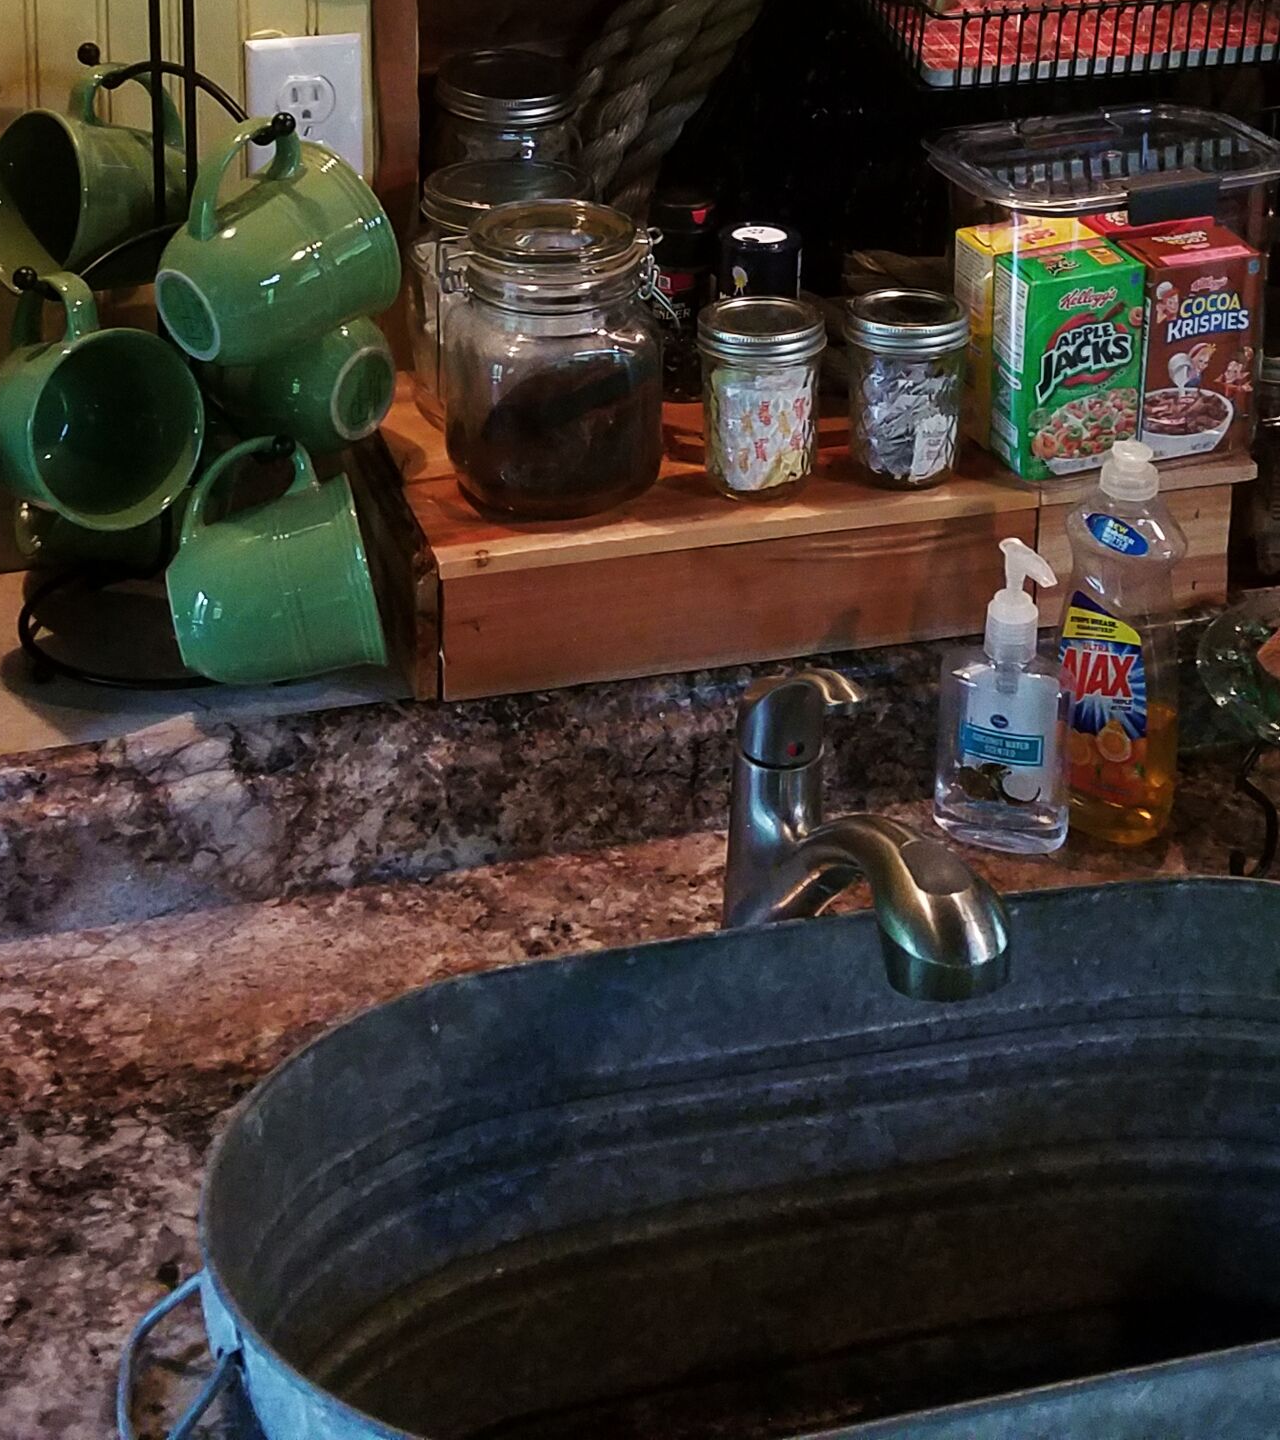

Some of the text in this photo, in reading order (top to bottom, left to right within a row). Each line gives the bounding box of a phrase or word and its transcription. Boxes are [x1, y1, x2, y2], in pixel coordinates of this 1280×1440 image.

[1058, 287, 1118, 311] Kellogg's
[1180, 292, 1241, 318] COCOA
[1055, 323, 1114, 352] APPLE
[1166, 309, 1250, 344] KRISPIES
[1036, 334, 1131, 402] JACKS
[1062, 647, 1136, 702] AJAX
